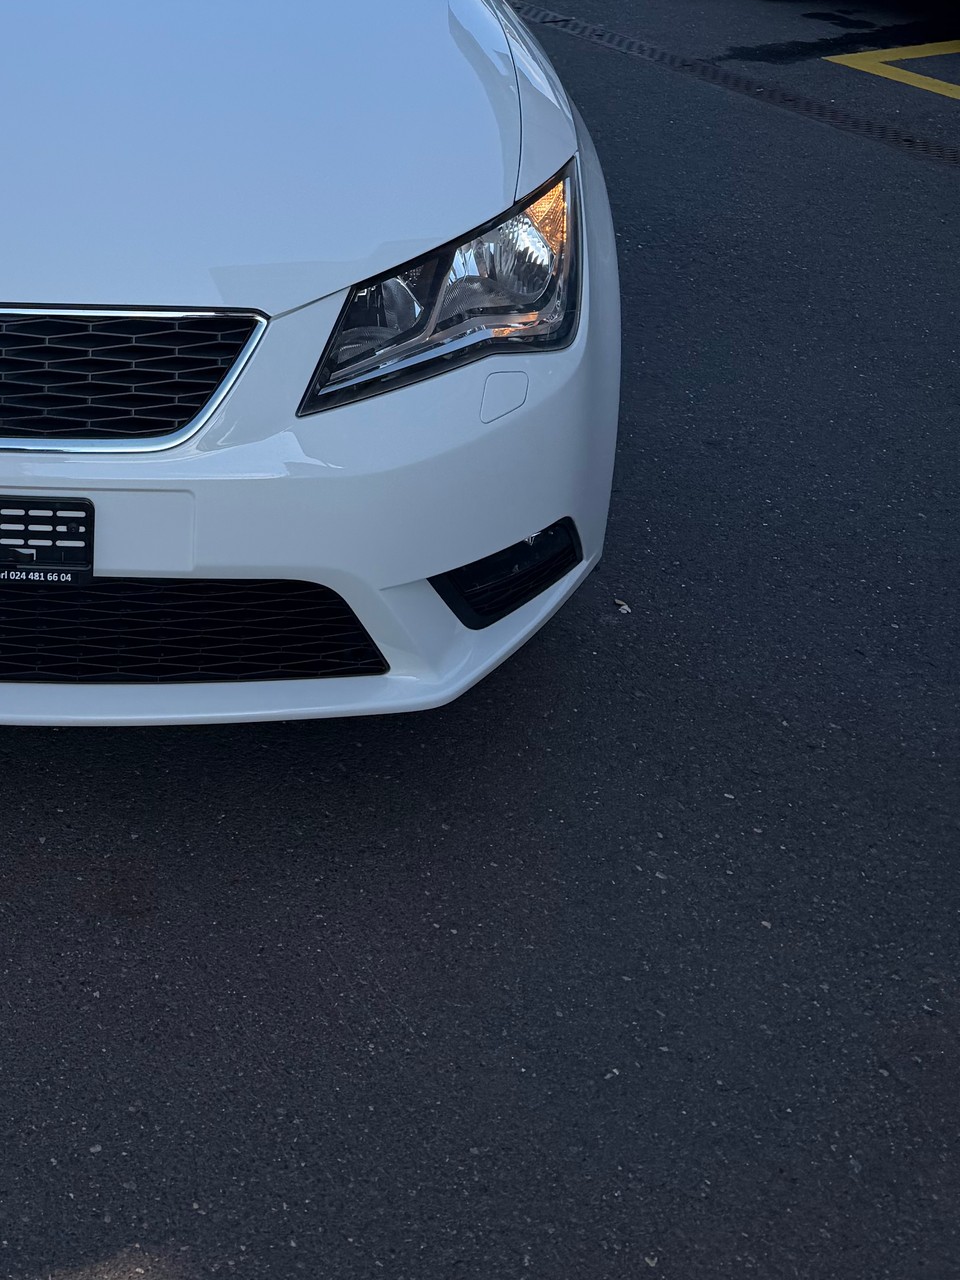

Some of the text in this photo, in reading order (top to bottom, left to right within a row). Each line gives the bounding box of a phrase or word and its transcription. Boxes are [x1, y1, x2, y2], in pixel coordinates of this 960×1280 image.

[9, 571, 26, 580] 024
[28, 572, 45, 580] 481
[47, 573, 58, 581] 66
[60, 573, 71, 581] 04
